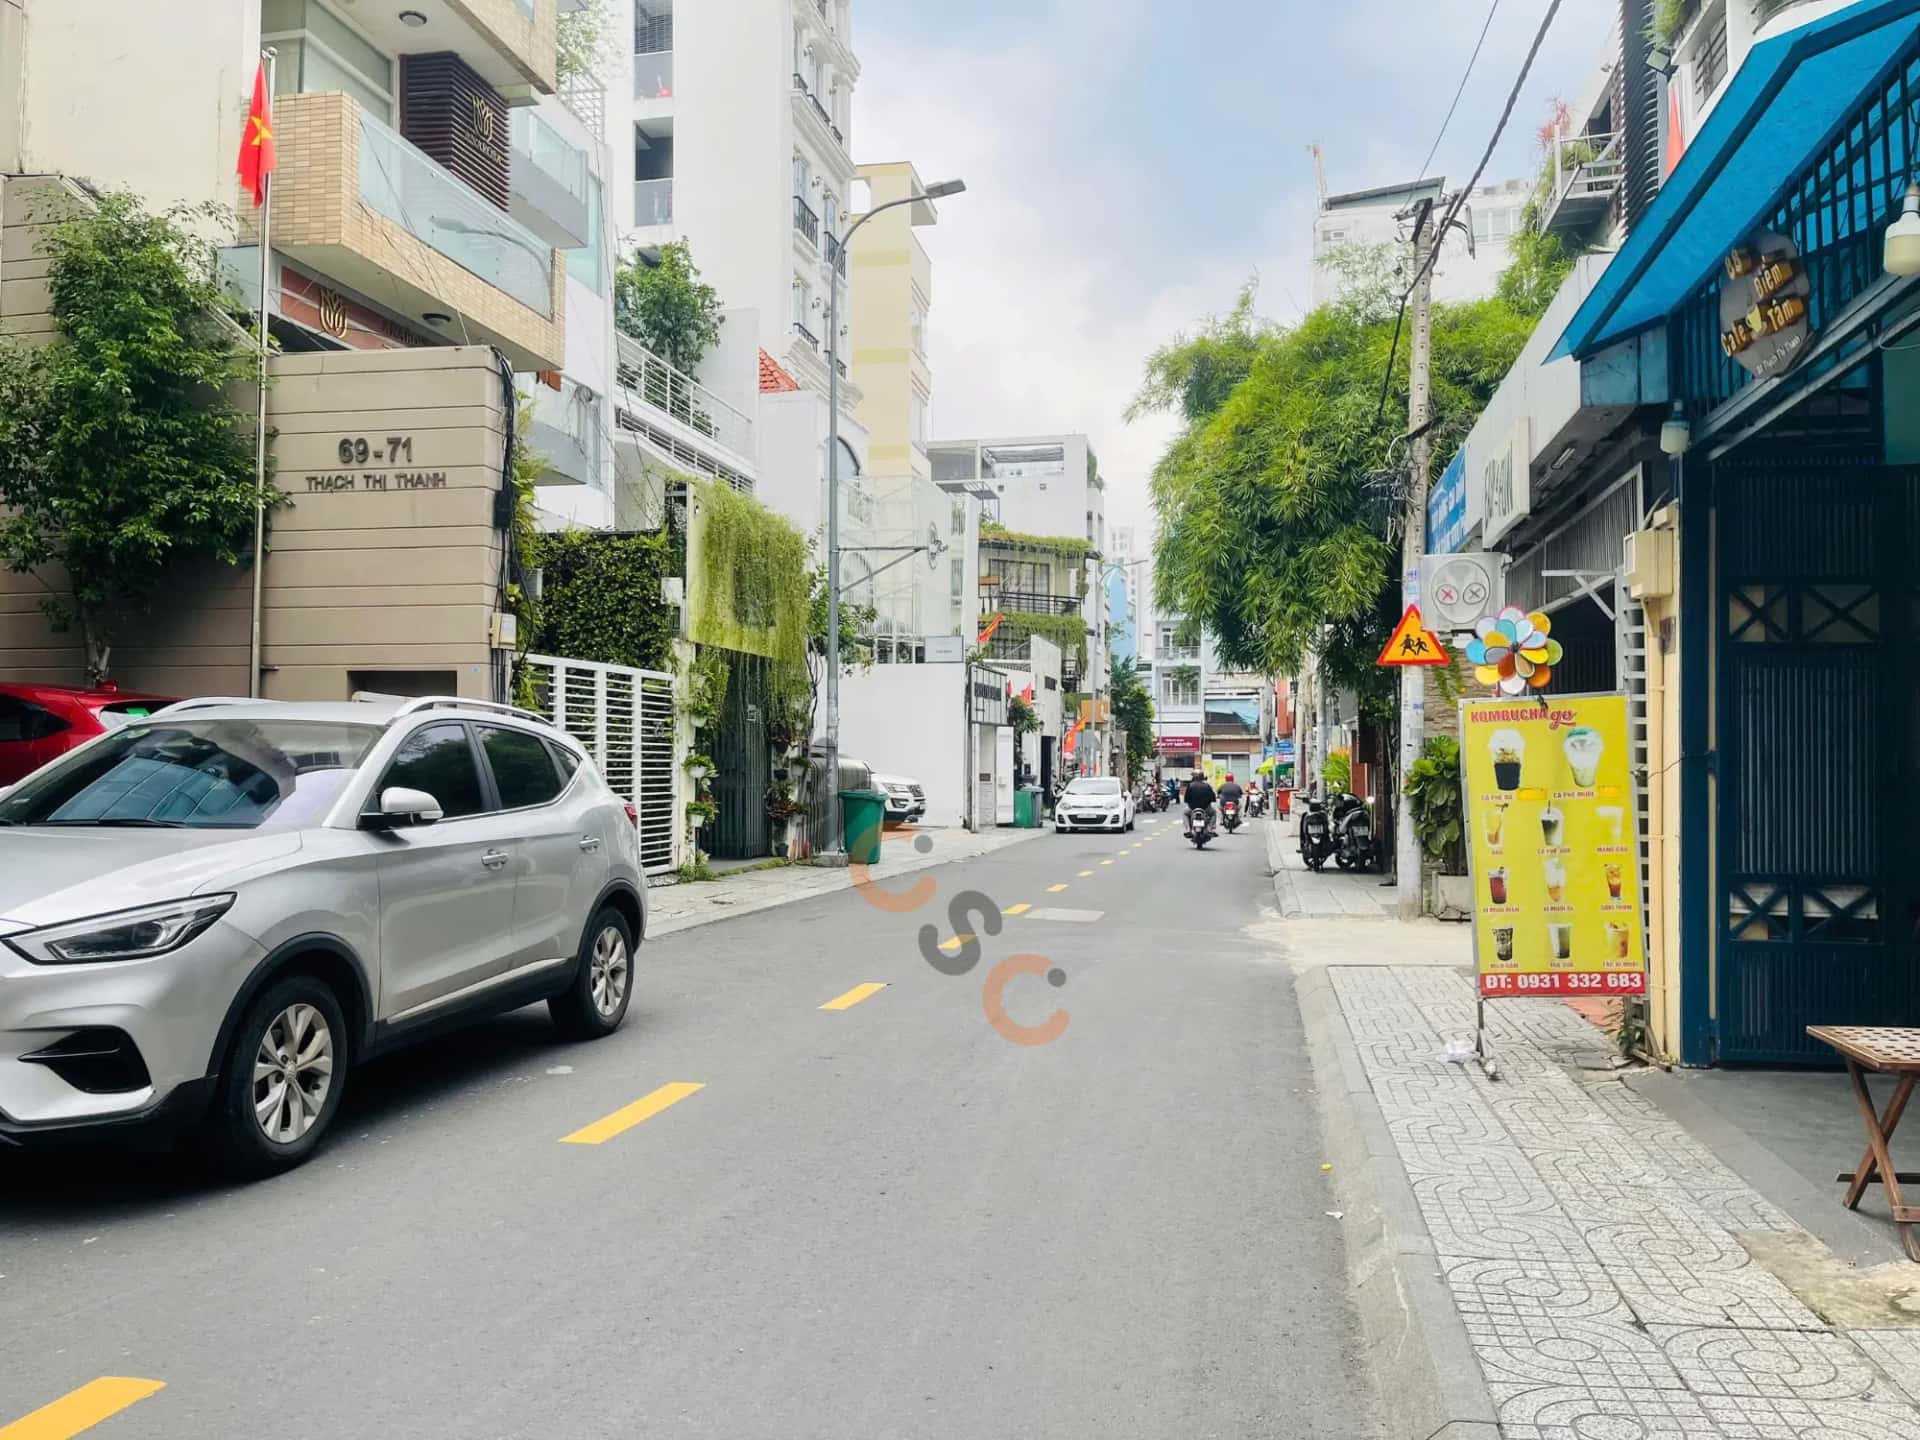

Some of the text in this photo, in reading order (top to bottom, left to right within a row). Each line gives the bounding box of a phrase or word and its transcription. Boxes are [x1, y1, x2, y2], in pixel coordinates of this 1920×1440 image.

[1721, 323, 1747, 357] Cafe
[305, 471, 447, 493] THẠCH THỊ THANH
[1471, 706, 1547, 722] KOMBUCHA
[1518, 975, 1560, 988] 0931
[1568, 974, 1601, 987] 332
[1607, 973, 1641, 987] 683
